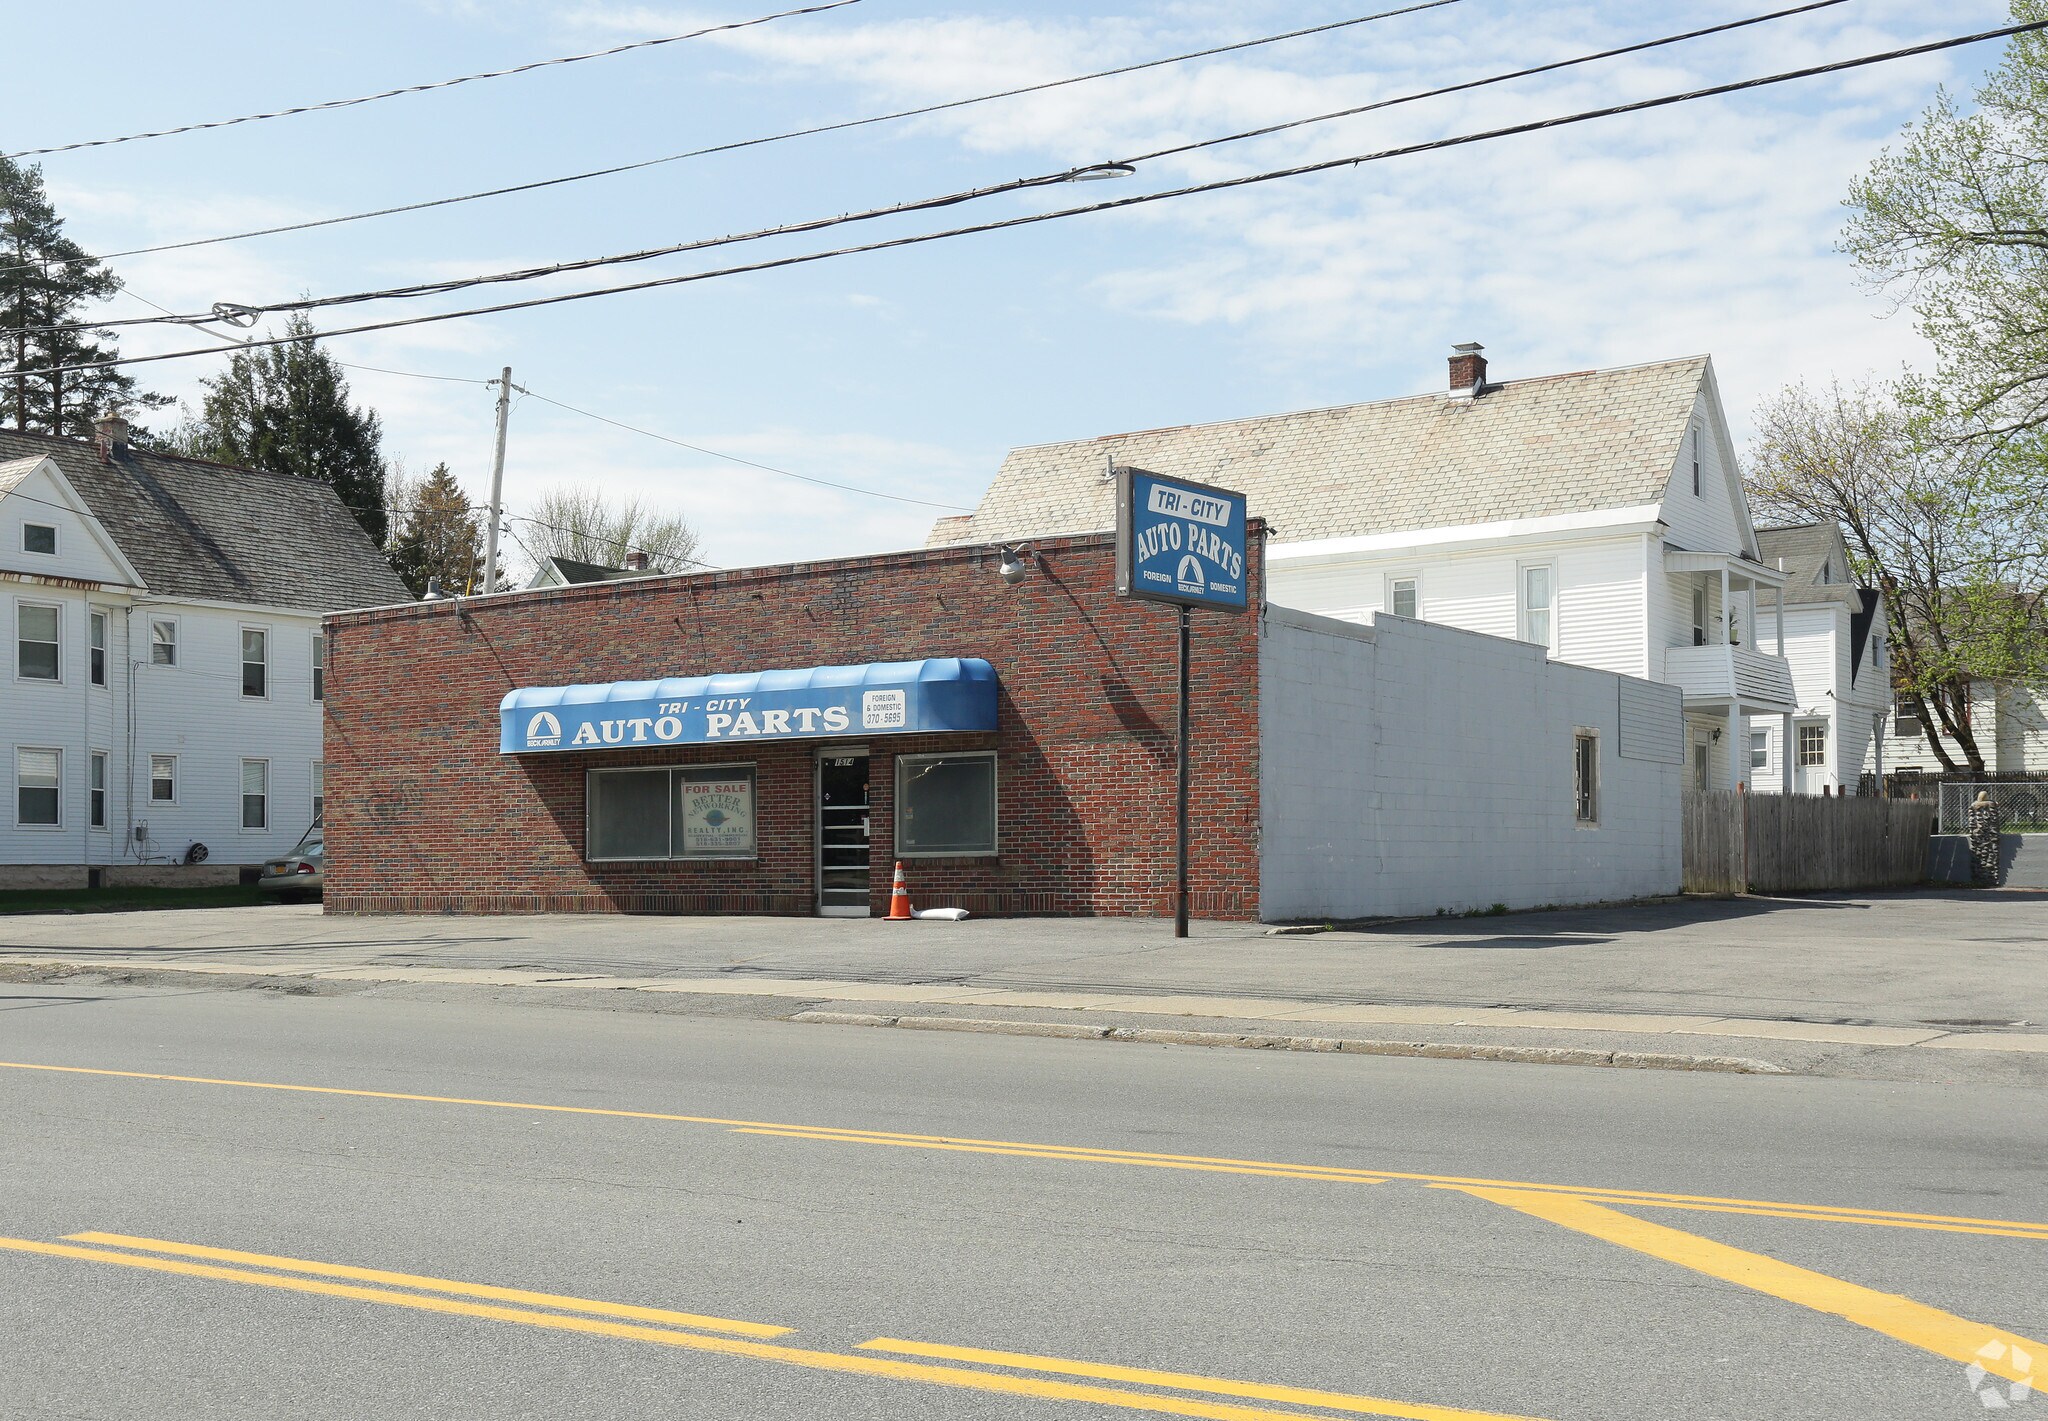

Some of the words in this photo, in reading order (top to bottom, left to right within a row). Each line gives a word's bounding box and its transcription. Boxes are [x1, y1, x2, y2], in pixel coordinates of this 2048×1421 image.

[1137, 522, 1181, 563] AUTO
[1187, 523, 1241, 579] PARTS
[1143, 570, 1172, 583] FOREIGN
[1210, 581, 1237, 594] DOMESTIC
[872, 694, 896, 702] FOREIGN
[873, 703, 902, 712] DOMESTIC
[571, 716, 683, 745] AUTO
[706, 706, 850, 737] PARTS
[685, 786, 710, 794] FOR
[715, 784, 746, 793] SALE
[692, 794, 741, 808] BETTER
[688, 802, 747, 818] NETWORKING
